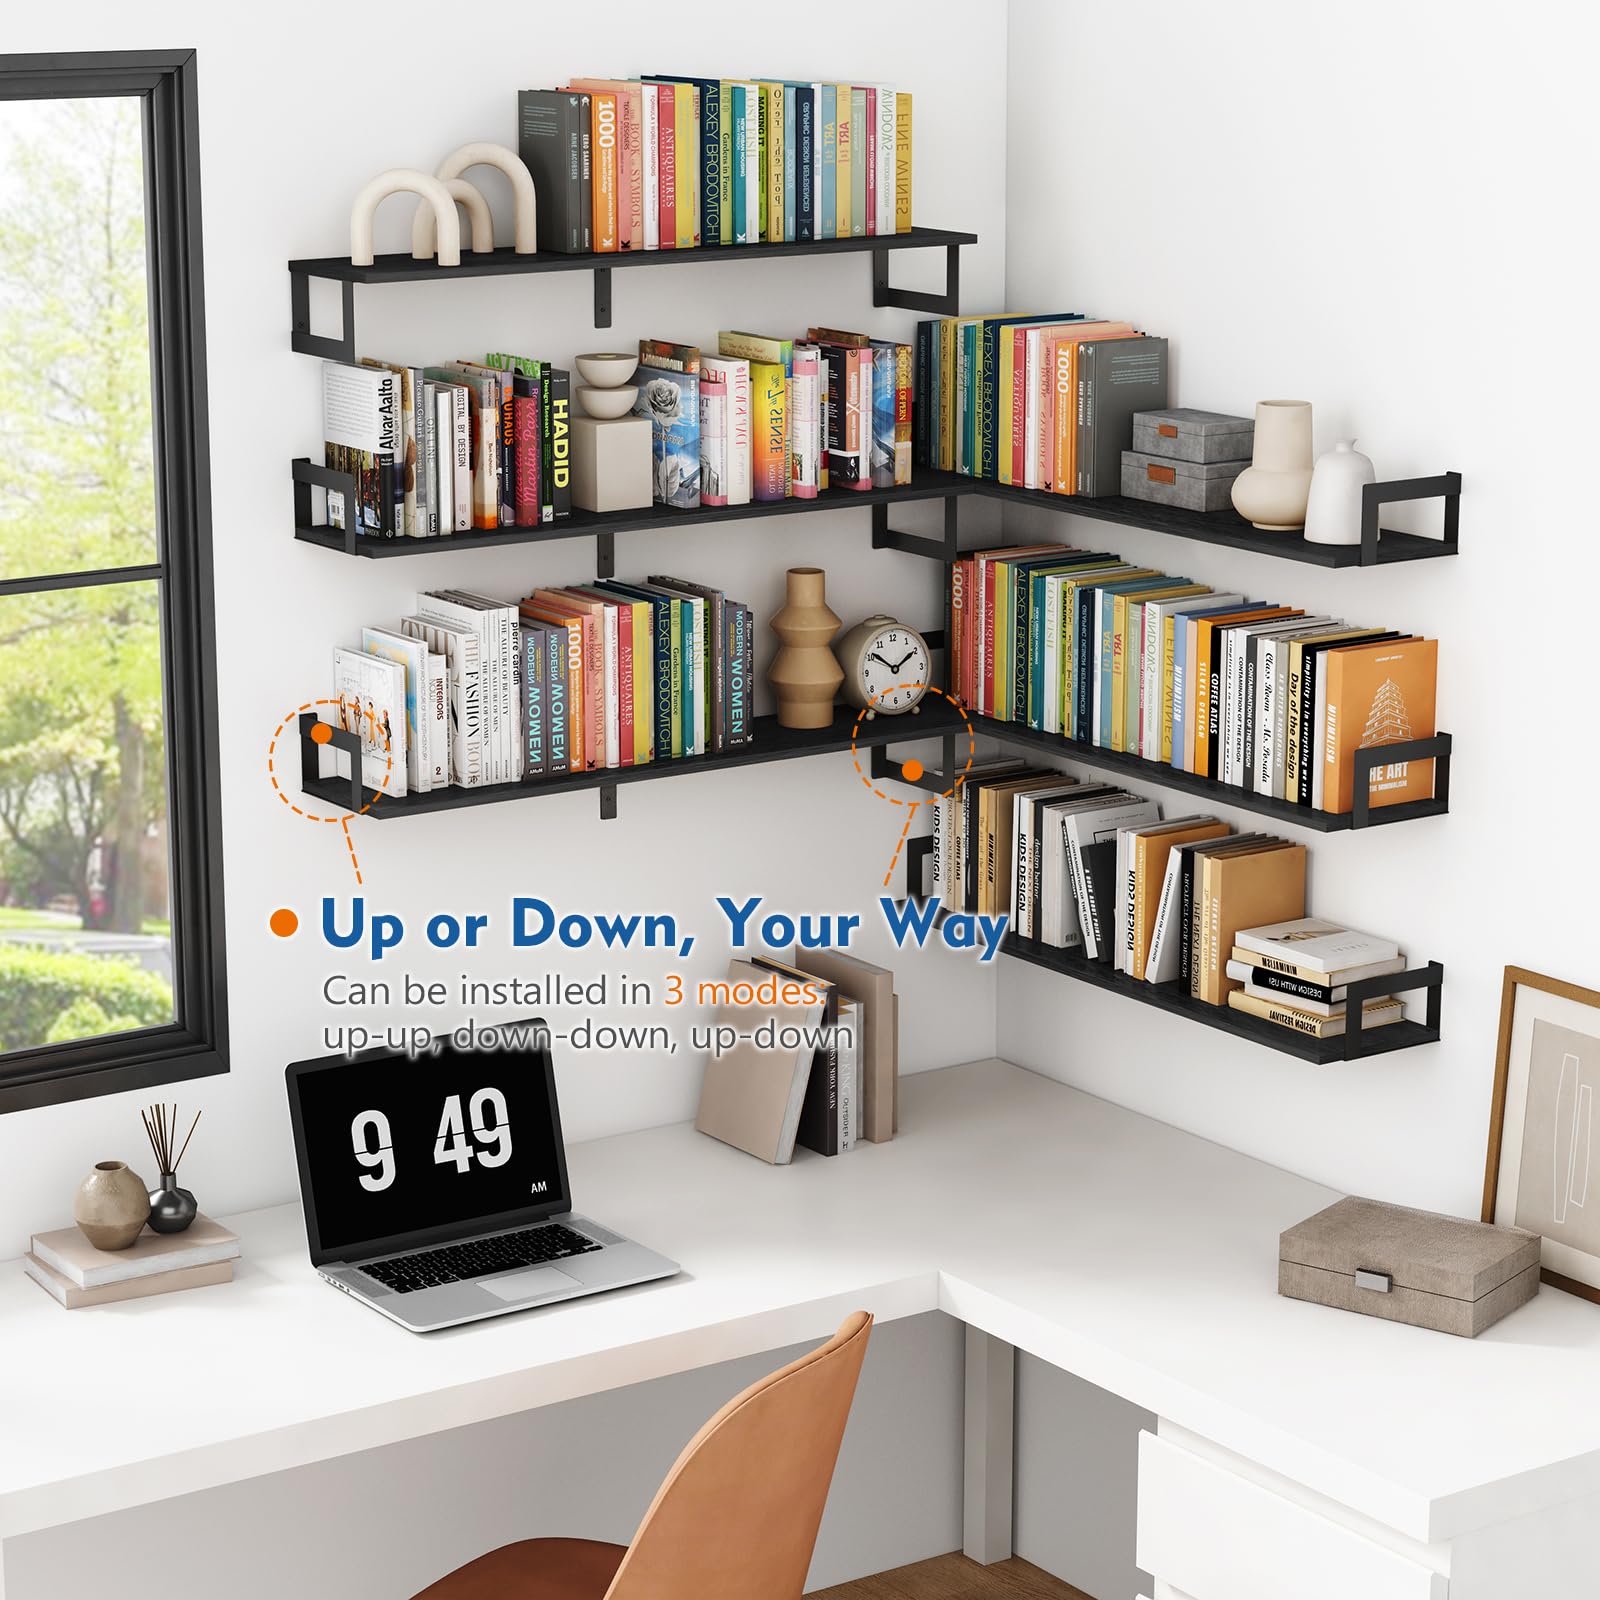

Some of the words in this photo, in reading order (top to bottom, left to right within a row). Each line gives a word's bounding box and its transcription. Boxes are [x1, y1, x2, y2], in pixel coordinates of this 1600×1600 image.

[599, 101, 614, 147] 1000
[706, 84, 718, 140] ALEXEY
[759, 137, 764, 146] IT
[707, 144, 718, 235] BRODOVITCH
[378, 379, 393, 414] Aalto
[457, 389, 465, 420] DIGITAL
[379, 415, 394, 450] Alvar
[458, 425, 465, 433] BY
[504, 386, 513, 446] BAUHAUS
[554, 399, 568, 488] HADID
[952, 565, 963, 609] 1000
[1018, 569, 1026, 623] ALEXEY
[659, 602, 670, 655] ALEXEY
[465, 635, 479, 669] THE
[568, 624, 581, 670] 1000
[501, 670, 507, 682] OF
[1264, 652, 1273, 680] Class
[1303, 656, 1312, 698] simplicity
[731, 659, 743, 733] WOMEN
[1173, 665, 1182, 722] MINIMALISM
[1211, 673, 1219, 705] COFFEE
[1264, 682, 1272, 712] Room
[1290, 673, 1298, 696] Day
[466, 671, 480, 738] FASHION
[660, 659, 671, 750] BRODOVITCH
[1237, 714, 1242, 723] OF
[1290, 700, 1298, 713] of
[1304, 710, 1310, 719] in
[1305, 701, 1310, 709] is
[1247, 719, 1252, 728] OF
[1262, 724, 1272, 744] Ms.
[1326, 704, 1336, 764] MINIMALISM
[435, 767, 441, 775] 2
[1262, 746, 1270, 783] Posada
[1288, 739, 1297, 780] design
[1302, 769, 1307, 780] we
[1387, 762, 1408, 779] ART
[1071, 840, 1083, 891] CONTAMINATION
[433, 1088, 512, 1174] 49
[351, 1110, 396, 1192] 9
[531, 1181, 547, 1194] AM
